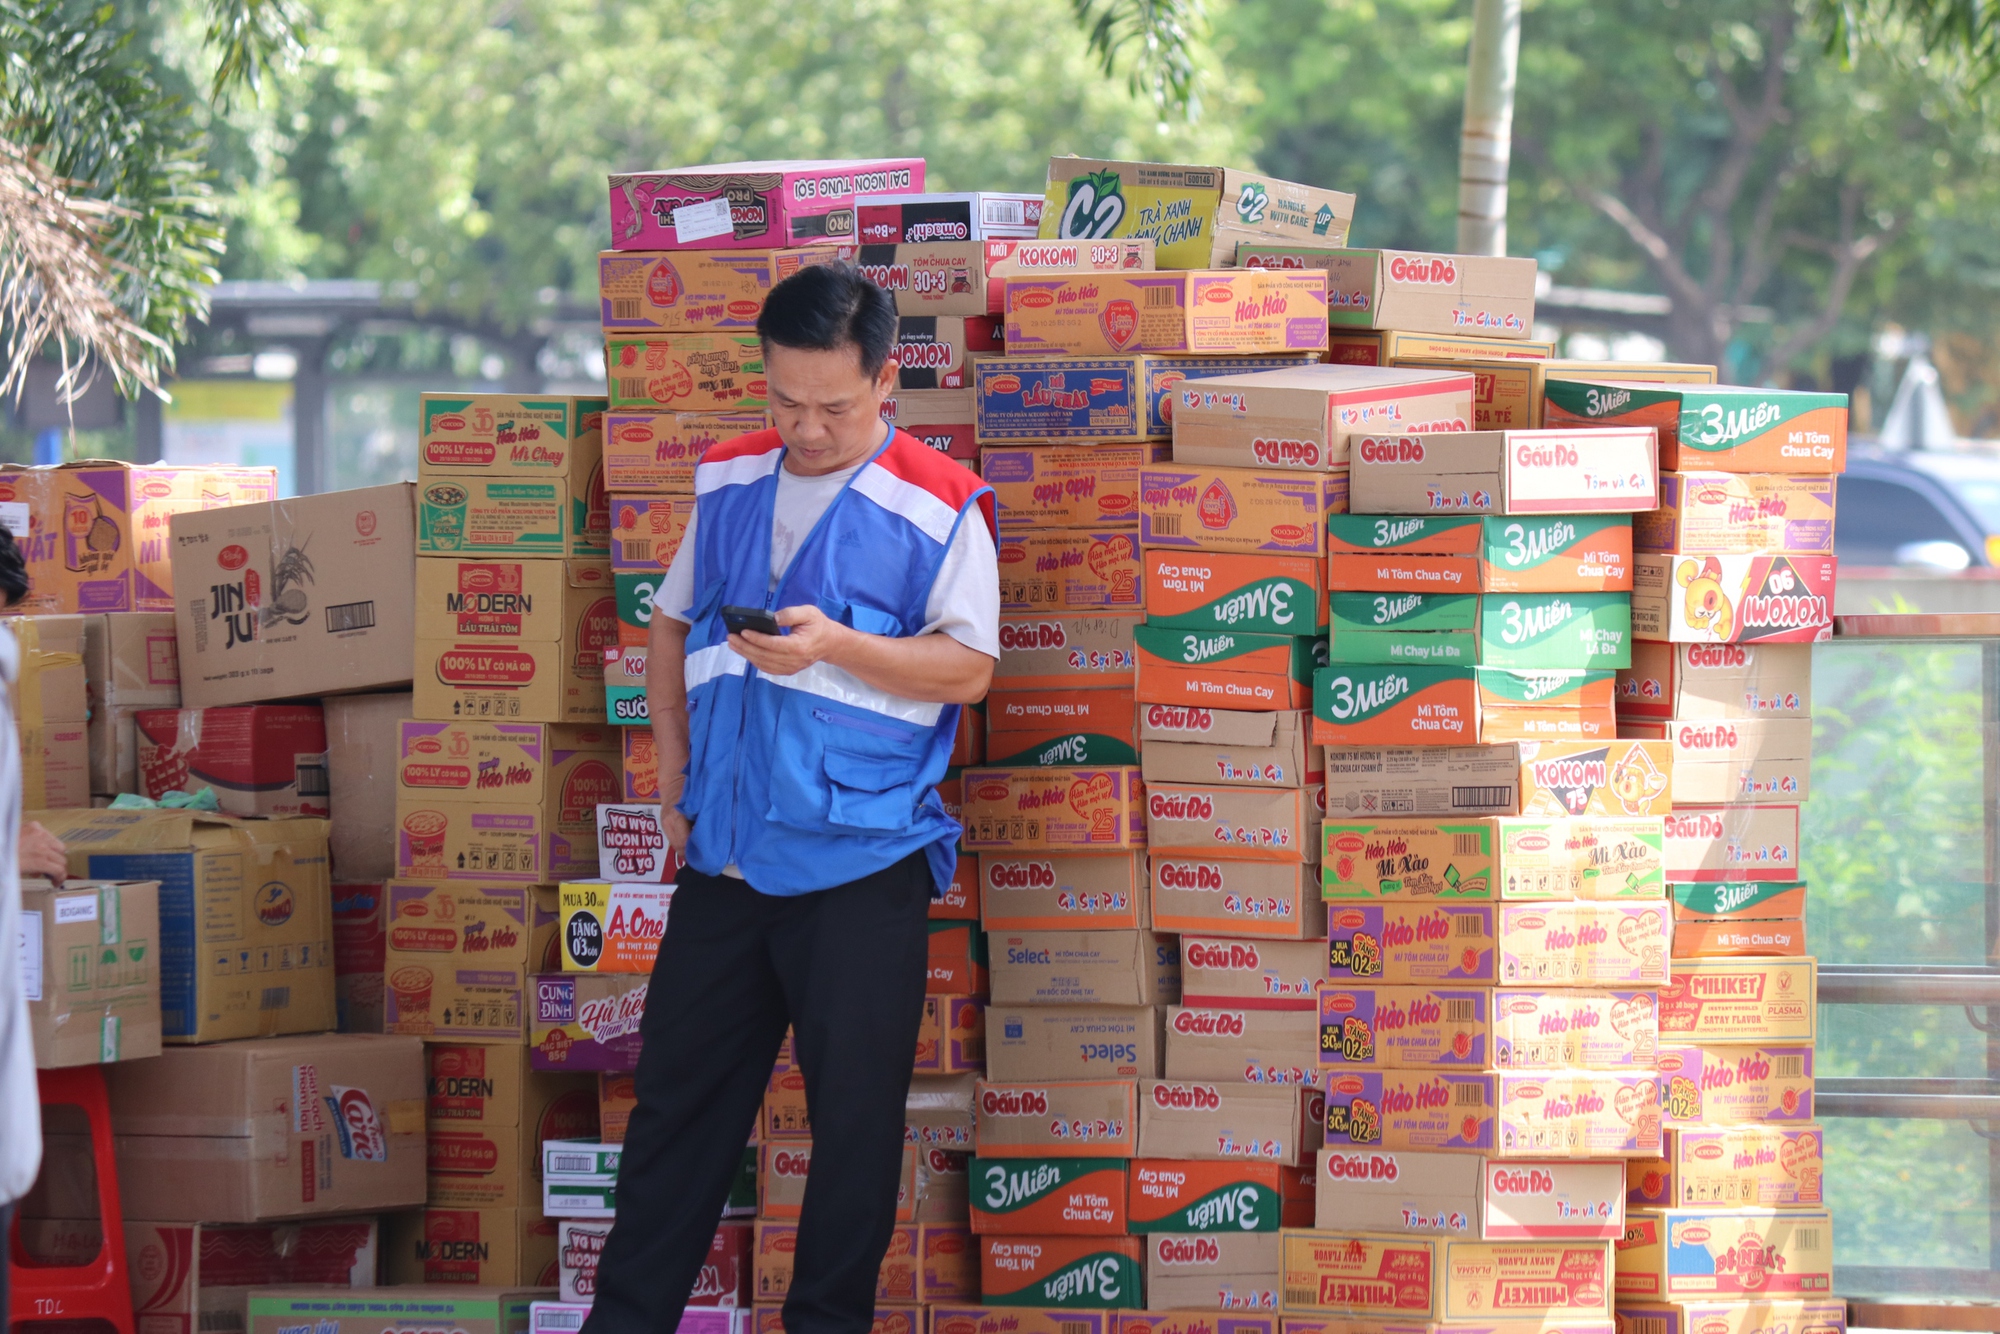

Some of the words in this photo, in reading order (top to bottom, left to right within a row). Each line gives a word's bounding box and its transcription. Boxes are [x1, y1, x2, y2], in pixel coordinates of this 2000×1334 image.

[855, 172, 886, 193] NGON
[1188, 175, 1210, 184] 600146
[727, 190, 750, 200] PRO
[1237, 185, 1269, 222] C2
[1140, 201, 1161, 226] TRÀ
[1164, 199, 1191, 221] XANH
[1277, 198, 1306, 213] HANDLE
[1270, 210, 1288, 222] WITH
[1289, 215, 1309, 228] CARE
[1318, 213, 1330, 224] UP
[914, 223, 966, 240] Omachi
[1164, 217, 1202, 245] CHANH
[991, 243, 1007, 256] MỚI
[1018, 245, 1078, 267] KOKOMI
[913, 258, 929, 266] TÔM
[914, 269, 946, 293] 30+3
[1235, 297, 1260, 322] Hảo
[1262, 291, 1287, 316] Hảo
[1452, 310, 1474, 326] Tôm
[1476, 311, 1502, 327] Chua
[1505, 313, 1525, 331] Cay
[1109, 404, 1128, 415] TÔM
[1494, 406, 1511, 423] TẾ
[1701, 403, 1723, 444] 3
[1723, 402, 1781, 440] Miền
[1789, 433, 1802, 443] Mì
[1805, 432, 1829, 444] Tôm
[510, 446, 529, 461] Mì
[532, 447, 564, 467] Chay
[1781, 445, 1810, 458] Chua
[1813, 445, 1834, 460] Cay
[1584, 474, 1607, 489] Tôm
[1613, 474, 1625, 488] và
[1629, 474, 1646, 488] Gà
[71, 511, 88, 524] 10
[211, 582, 243, 619] JIN
[447, 593, 532, 615] MODERN
[1743, 595, 1826, 627] KOKOMI
[225, 613, 252, 649] JU
[478, 622, 498, 632] THÁI
[501, 624, 518, 632] TÔM
[1390, 645, 1402, 656] Mì
[1404, 646, 1430, 659] Chay
[1432, 646, 1443, 656] Lá
[1445, 646, 1460, 657] Đa
[444, 657, 476, 670] 100%
[478, 658, 491, 670] LY
[494, 661, 504, 671] CÓ
[506, 661, 518, 671] MÃ
[520, 664, 531, 672] QR
[1347, 753, 1352, 761] 75
[477, 768, 503, 789] Hảo
[506, 763, 532, 784] Hảo
[1331, 764, 1339, 773] TÔM
[1340, 764, 1351, 773] CHUA
[1352, 764, 1360, 772] CAY
[1361, 764, 1376, 772] CHANH
[1535, 761, 1606, 788] KOKOMI
[1566, 788, 1588, 807] 75
[607, 833, 638, 846] NGON
[642, 835, 660, 846] DAI
[1215, 827, 1233, 841] Gà
[1237, 830, 1259, 846] Sợi
[1263, 828, 1289, 845] Phở
[618, 859, 634, 871] TO
[1377, 858, 1397, 878] Mì
[563, 894, 582, 906] MUA
[585, 892, 596, 906] 30
[1714, 886, 1727, 912] 3
[1727, 884, 1758, 910] Miền
[608, 905, 663, 938] A-One
[1382, 922, 1413, 948] Hảo
[1416, 915, 1449, 942] Hảo
[573, 939, 587, 956] 03
[1008, 949, 1050, 963] Select
[1352, 953, 1370, 974] 02
[540, 985, 573, 1000] CUNG
[1691, 976, 1761, 998] MILIKET
[541, 1001, 572, 1017] ĐÌNH
[582, 999, 616, 1031] Hủ
[1704, 1016, 1729, 1024] SATAY
[1733, 1016, 1761, 1024] FLAVOR
[548, 1051, 566, 1061] 85g
[1080, 1044, 1136, 1062] Select
[1702, 1060, 1733, 1091] Hảo
[1736, 1053, 1770, 1083] Hảo
[1050, 1121, 1069, 1138] Gà
[1072, 1122, 1093, 1140] Sợi
[1098, 1121, 1122, 1138] Phở
[985, 1167, 1006, 1208] 3
[1006, 1166, 1060, 1206] Miền
[1069, 1195, 1082, 1206] Mì
[1085, 1195, 1108, 1207] Tôm
[1558, 1201, 1579, 1218] Tôm
[1583, 1202, 1594, 1216] và
[1598, 1202, 1613, 1218] Gà
[1063, 1208, 1091, 1220] Chua
[1093, 1209, 1114, 1223] Cay
[415, 1241, 488, 1261] MODERN
[1503, 1287, 1568, 1305] MILIKET
[35, 1299, 64, 1314] TDL
